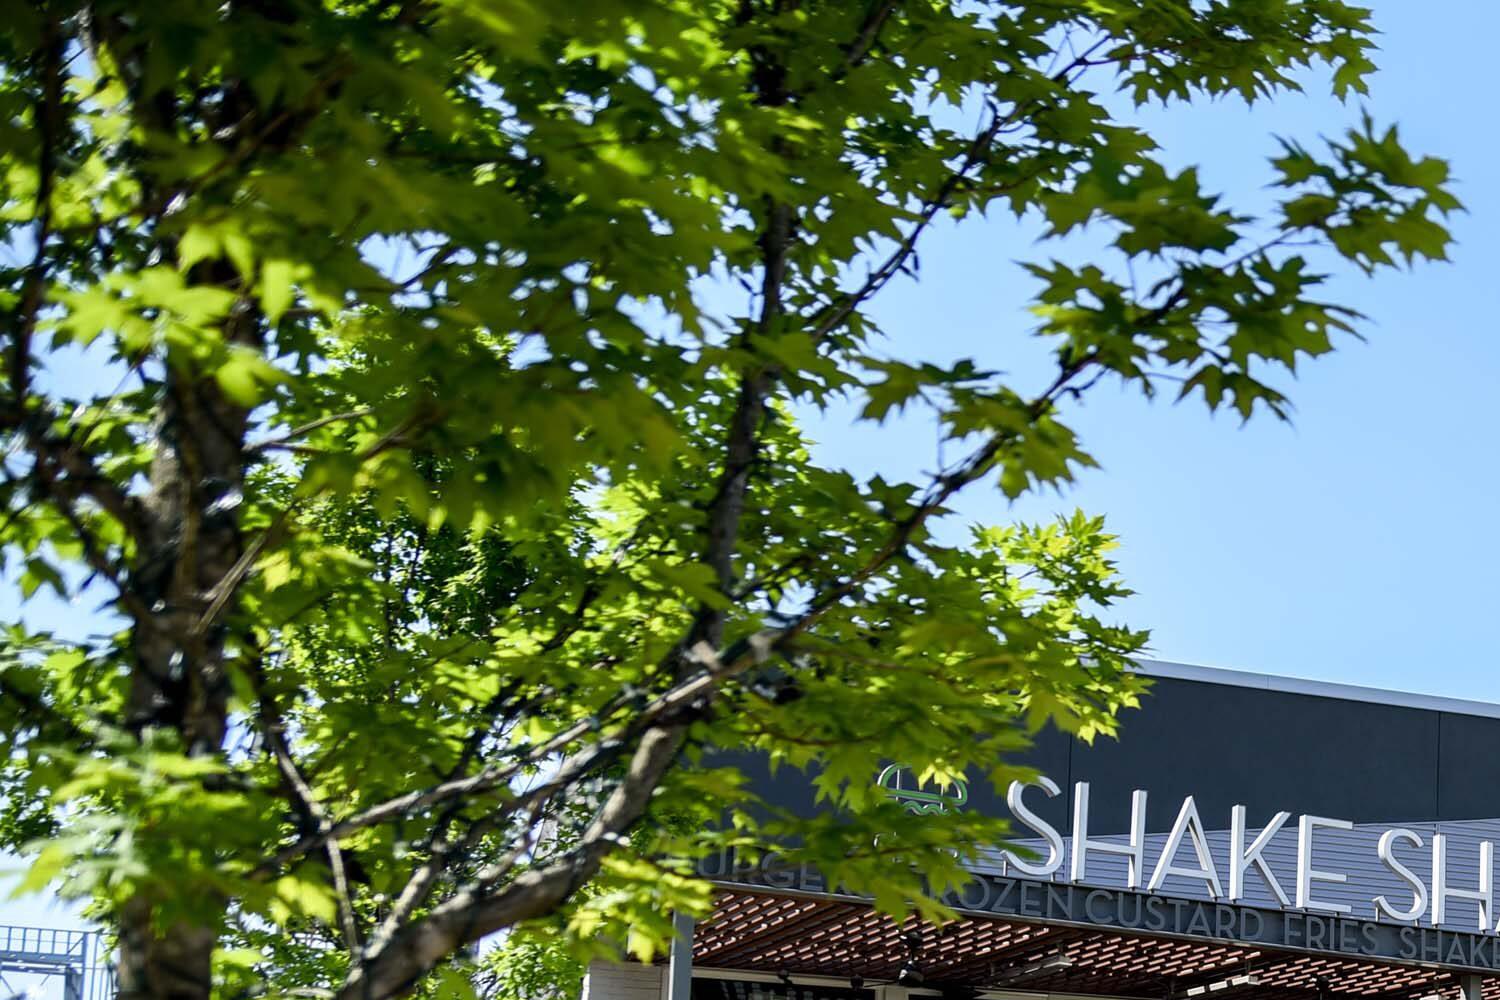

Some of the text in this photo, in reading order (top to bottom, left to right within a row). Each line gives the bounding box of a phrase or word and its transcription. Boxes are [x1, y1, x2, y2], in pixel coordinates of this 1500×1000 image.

[1000, 775, 1354, 913] SHAKE
[929, 874, 1073, 920] OZEN
[1084, 890, 1265, 941] CUSTARD
[1284, 913, 1378, 955] FRIES
